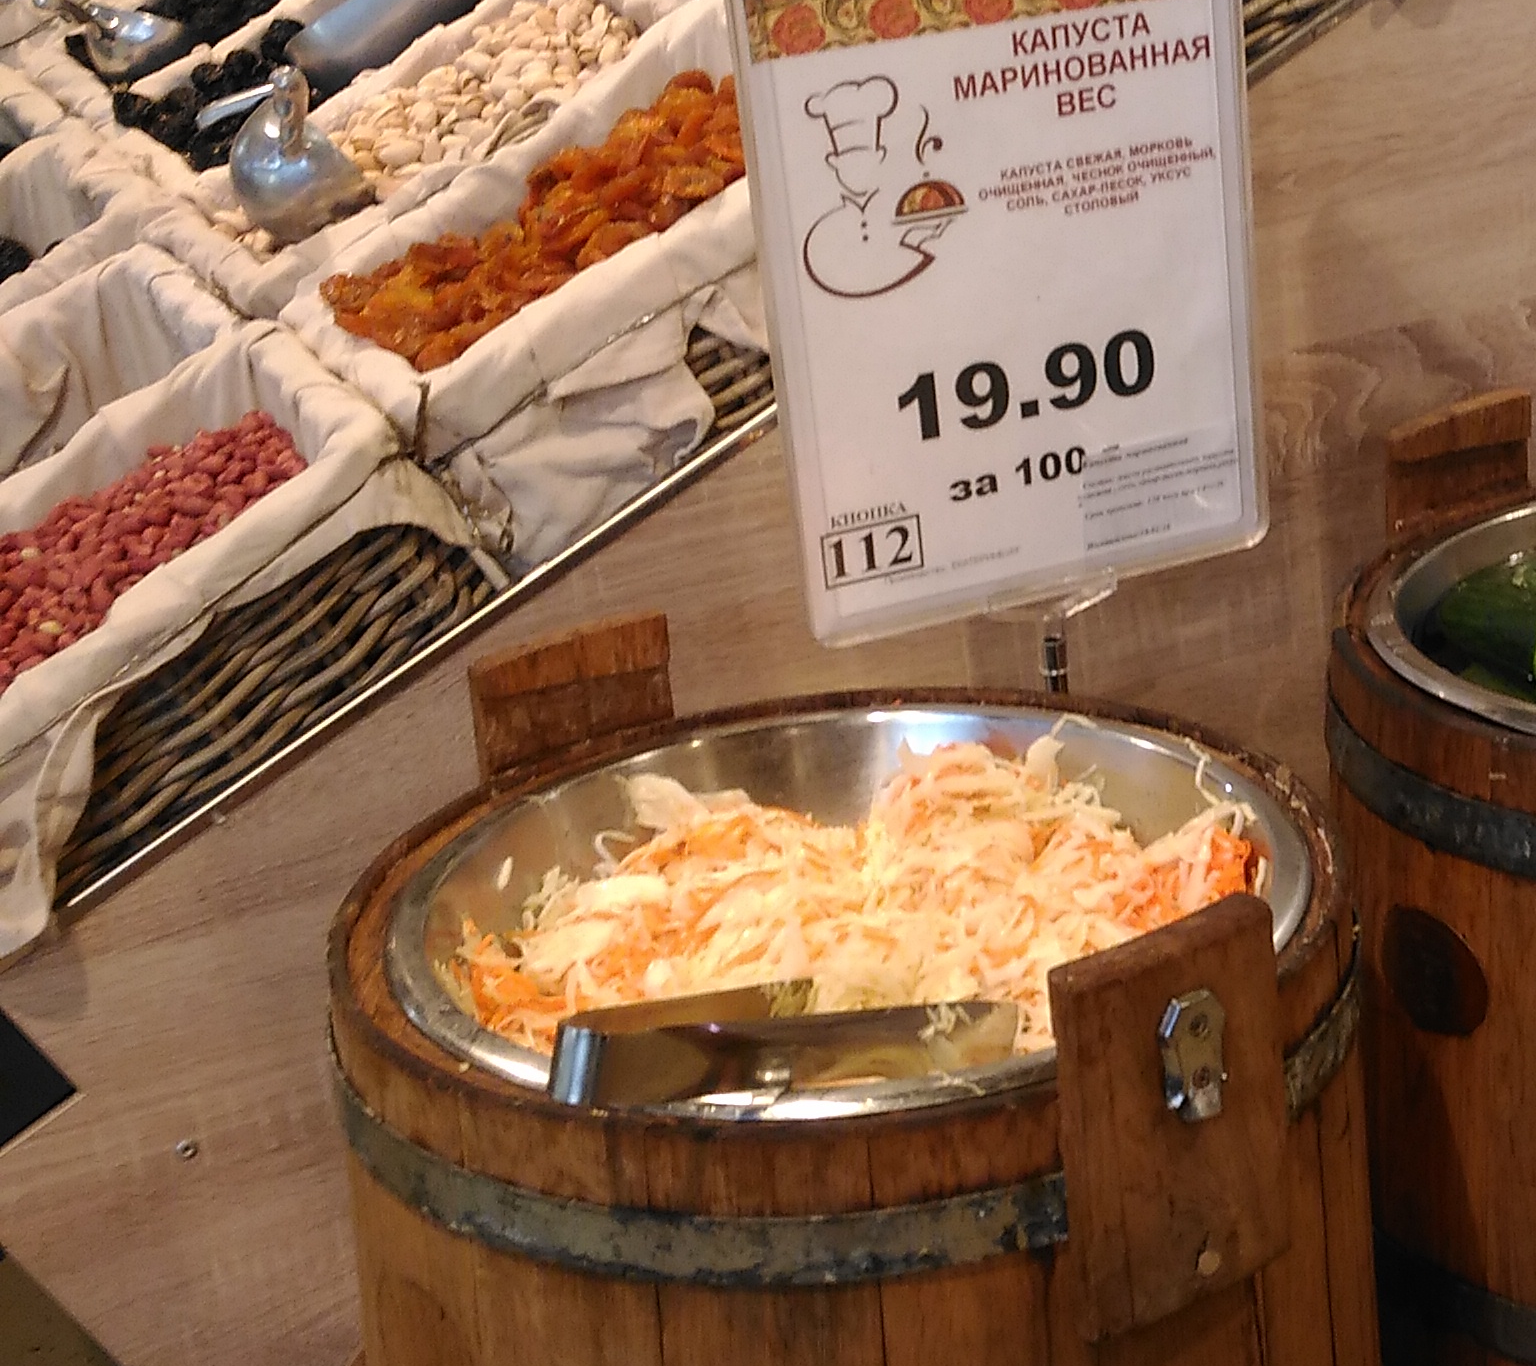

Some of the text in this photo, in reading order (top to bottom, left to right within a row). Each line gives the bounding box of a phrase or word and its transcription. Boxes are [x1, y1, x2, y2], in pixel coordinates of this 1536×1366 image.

[1012, 12, 1151, 57] КАПУСТА
[953, 34, 1212, 102] МАРИНОВАННАЯ
[1057, 84, 1117, 118] ВЕС
[1000, 159, 1063, 181] КАПУСТА
[1129, 136, 1193, 157] МОРКОВЬ
[1150, 167, 1192, 184] УКСУС
[1064, 190, 1140, 216] СТОЛОВЫЙ
[898, 327, 1157, 443] 19.90
[949, 469, 999, 504] за
[1014, 444, 1087, 489] 100
[830, 501, 907, 530] КНОПКА
[828, 524, 913, 580] 112
